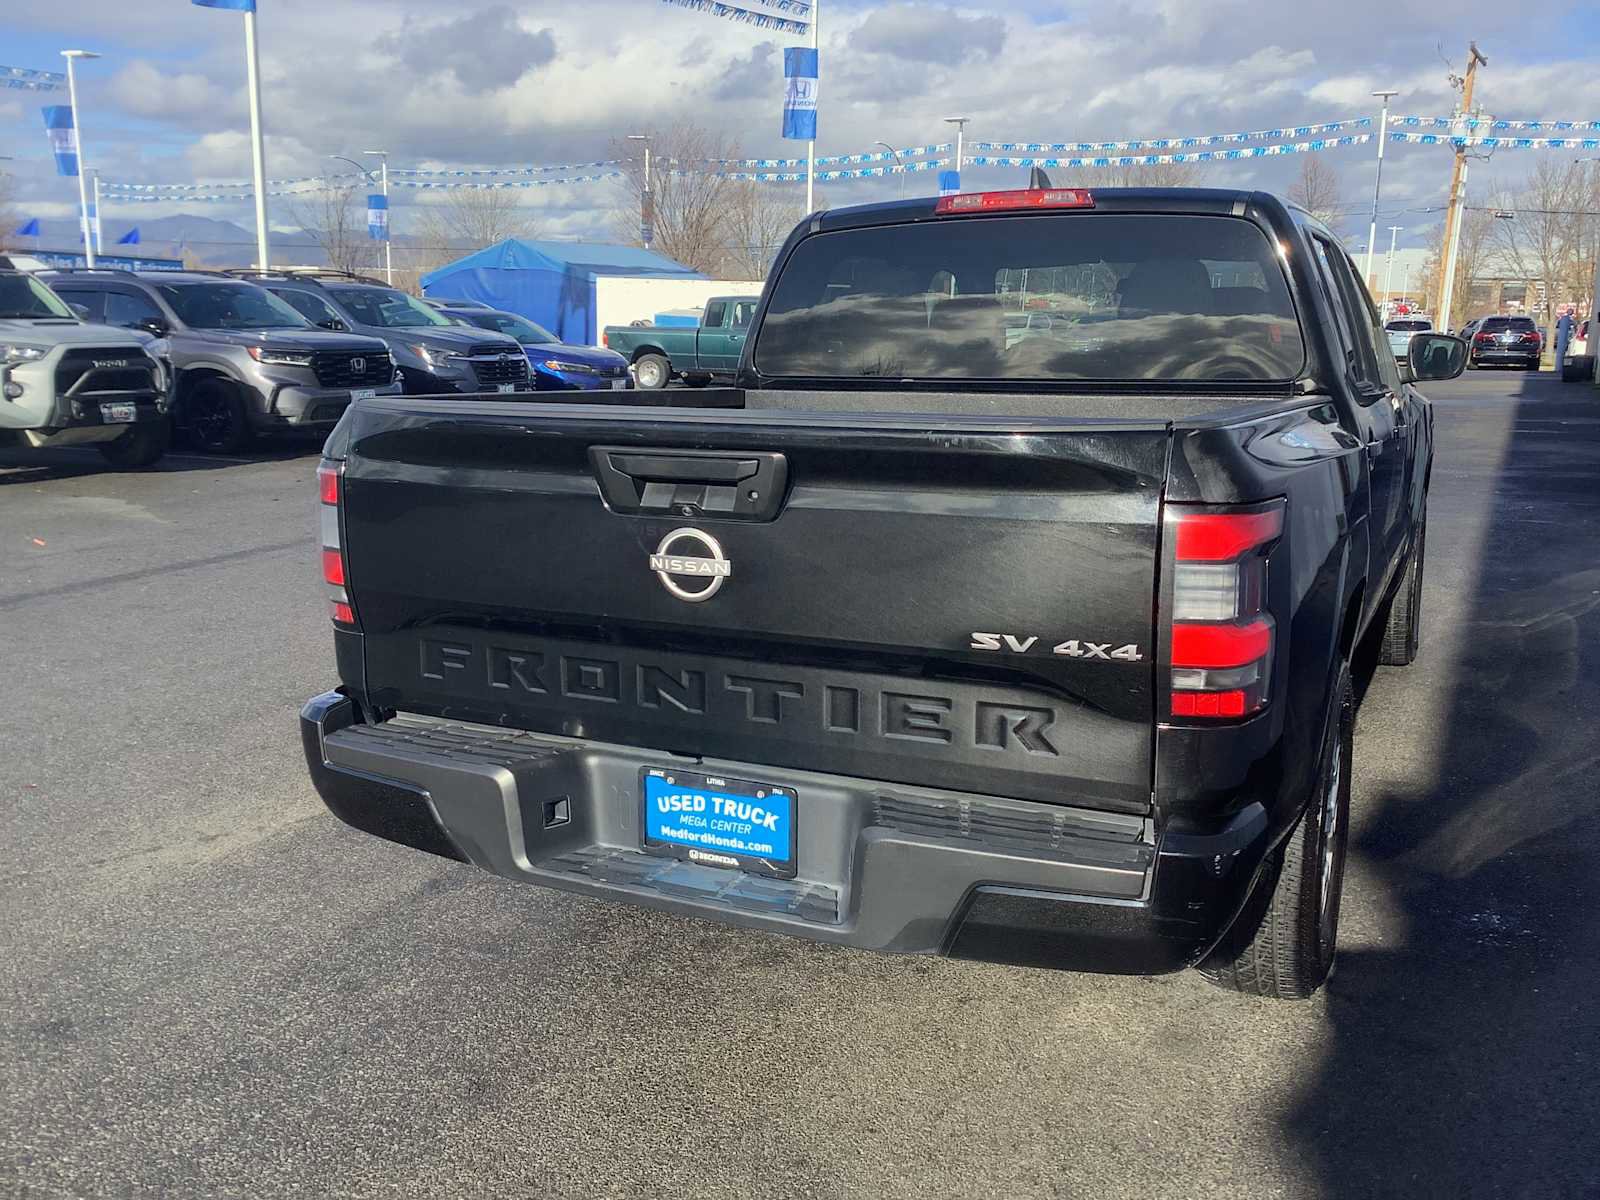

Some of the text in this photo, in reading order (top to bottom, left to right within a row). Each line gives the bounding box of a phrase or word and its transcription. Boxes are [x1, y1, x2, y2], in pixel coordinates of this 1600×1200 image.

[651, 557, 729, 574] NISSAN
[970, 632, 1039, 653] SV
[419, 639, 1060, 757] FRONTIER
[657, 795, 779, 831] USED TRUCK
[679, 814, 751, 834] MEGA CENTER
[661, 826, 772, 852] MedfordHonda.com
[700, 853, 739, 866] HONDA
